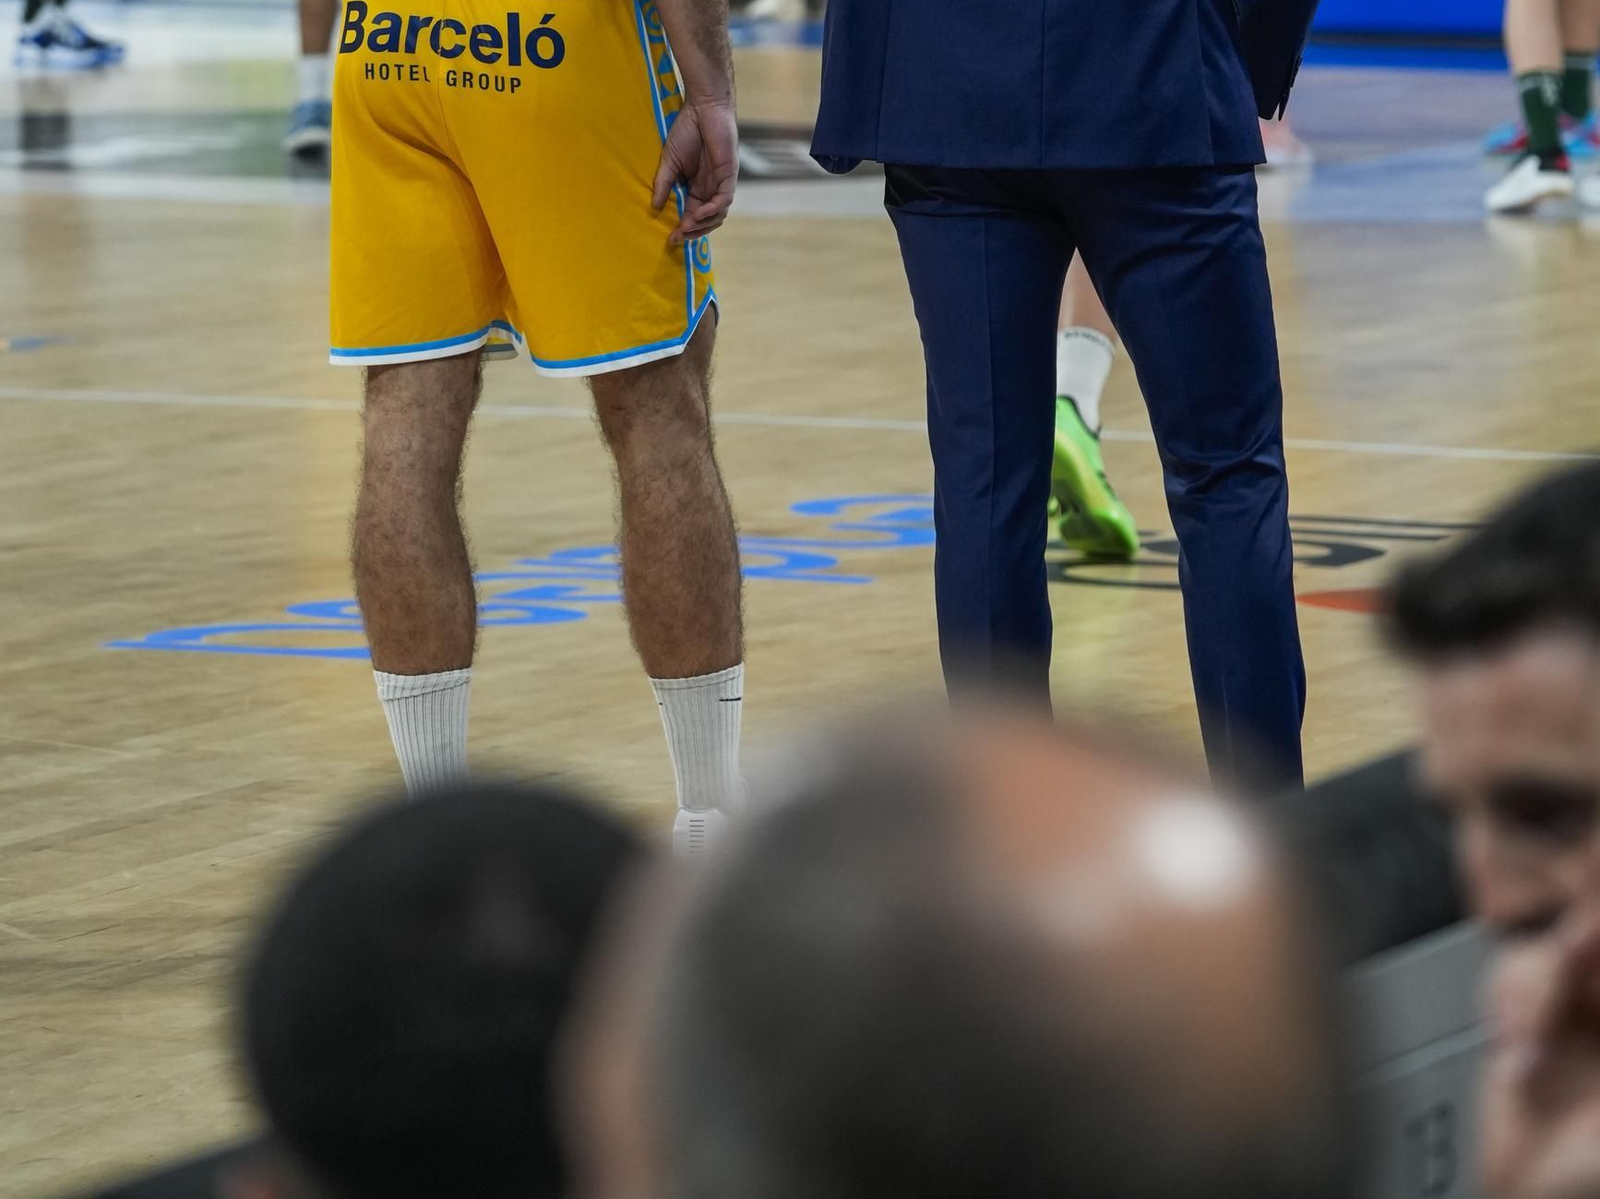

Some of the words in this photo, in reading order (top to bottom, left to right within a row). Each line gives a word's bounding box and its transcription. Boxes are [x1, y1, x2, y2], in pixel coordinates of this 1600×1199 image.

[339, 0, 566, 69] Barceló
[364, 63, 431, 83] HOTEL
[446, 70, 521, 94] GROUP
